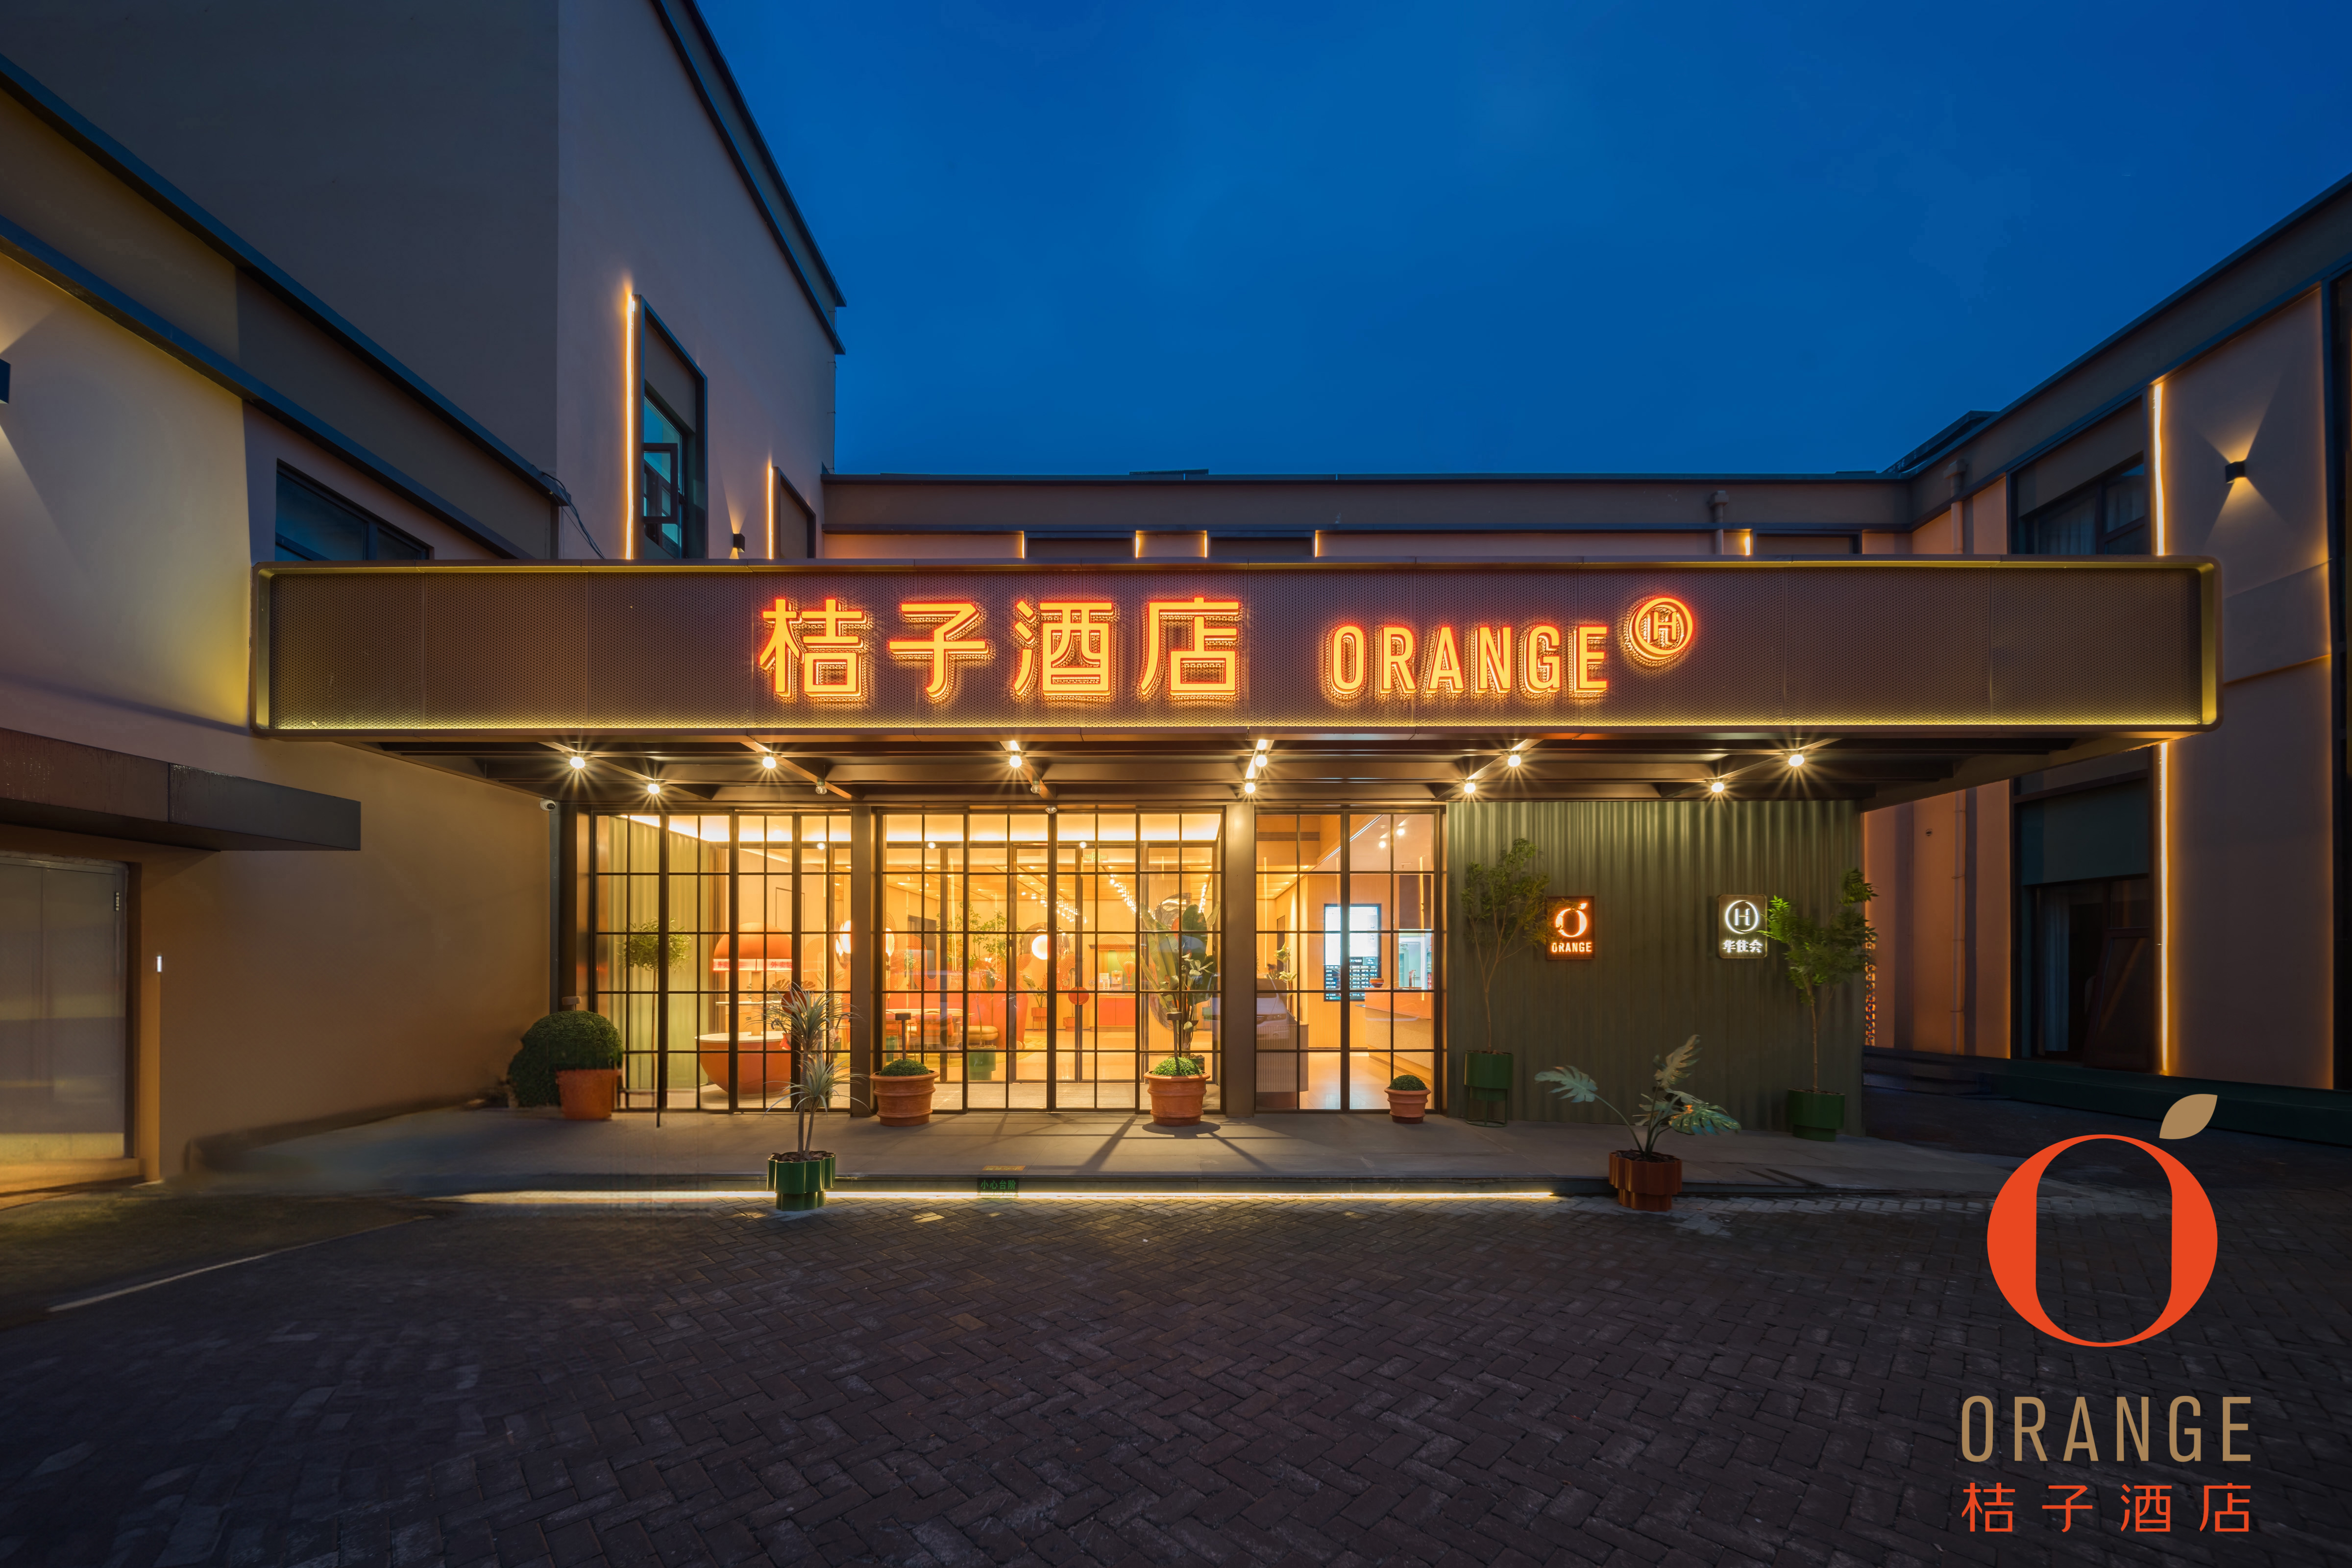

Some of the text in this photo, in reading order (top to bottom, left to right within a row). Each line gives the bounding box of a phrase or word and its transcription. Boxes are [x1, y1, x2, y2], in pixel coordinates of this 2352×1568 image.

[760, 597, 1240, 696] 桔子酒店
[1331, 625, 1608, 692] ORANGE
[1552, 942, 1592, 952] ORANGE
[1723, 939, 1764, 953] 华住会
[980, 1179, 1016, 1190] 小心台阶
